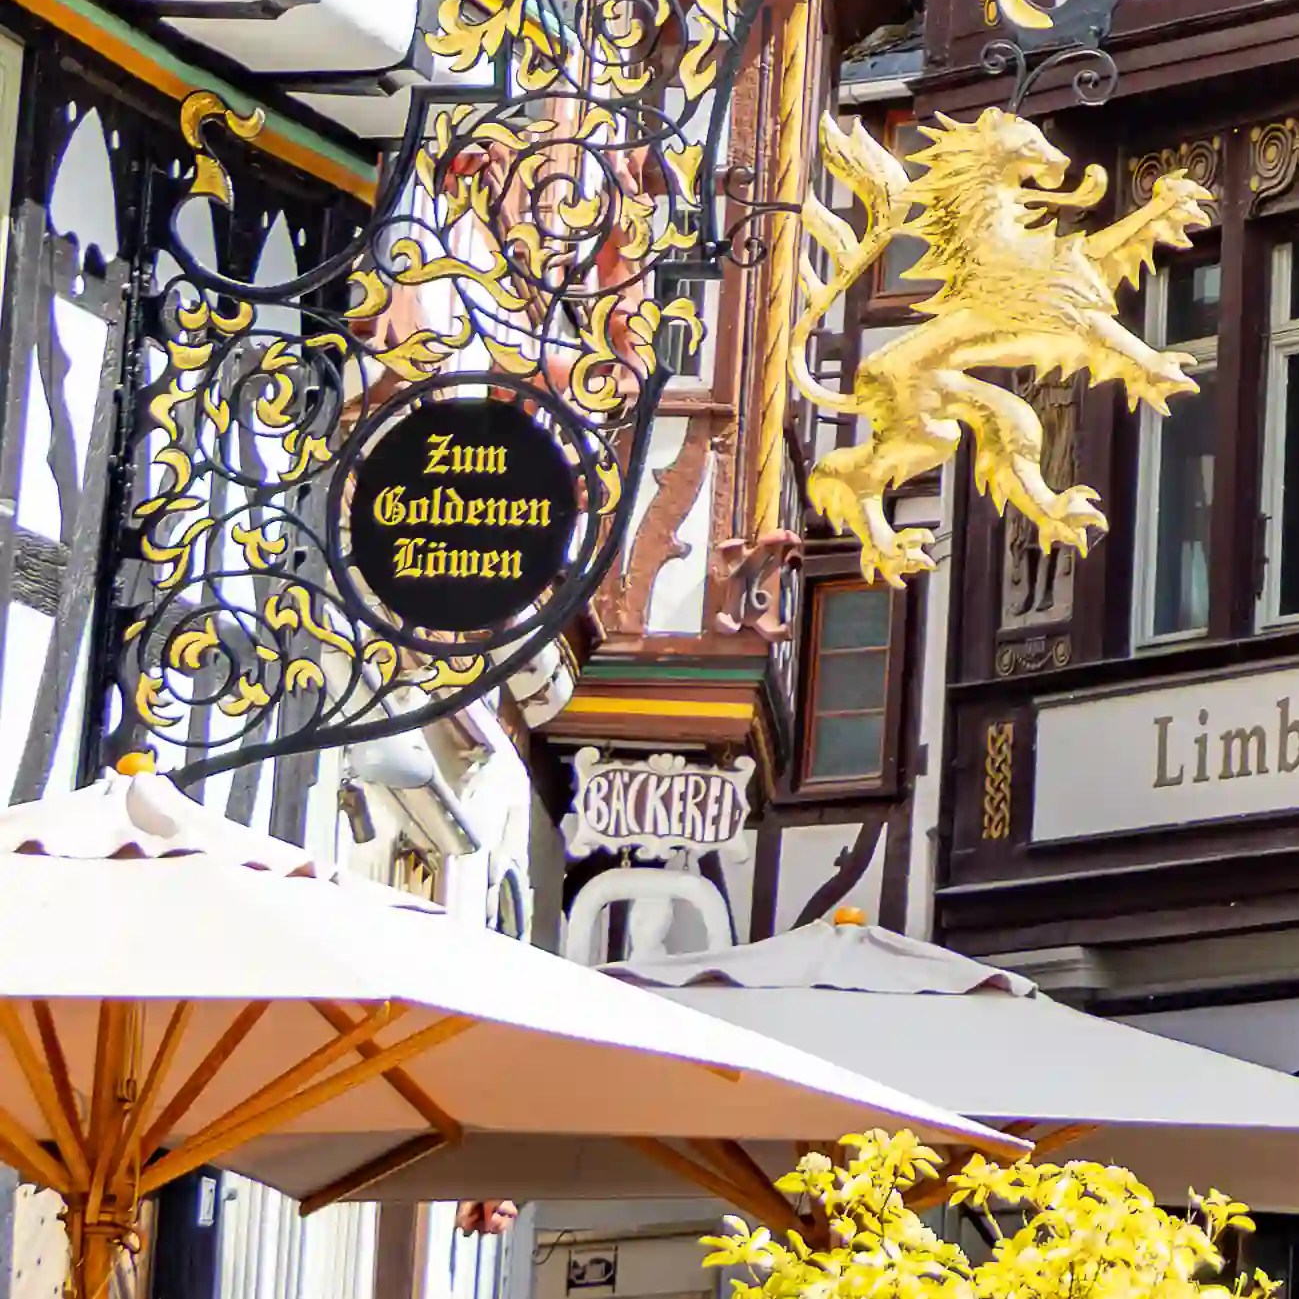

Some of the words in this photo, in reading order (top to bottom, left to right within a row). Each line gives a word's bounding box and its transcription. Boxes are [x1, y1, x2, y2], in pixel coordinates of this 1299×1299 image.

[423, 433, 508, 475] Zum
[373, 485, 551, 527] Goldenen
[392, 537, 524, 579] Löwen
[586, 770, 734, 843] BÄCKEREI
